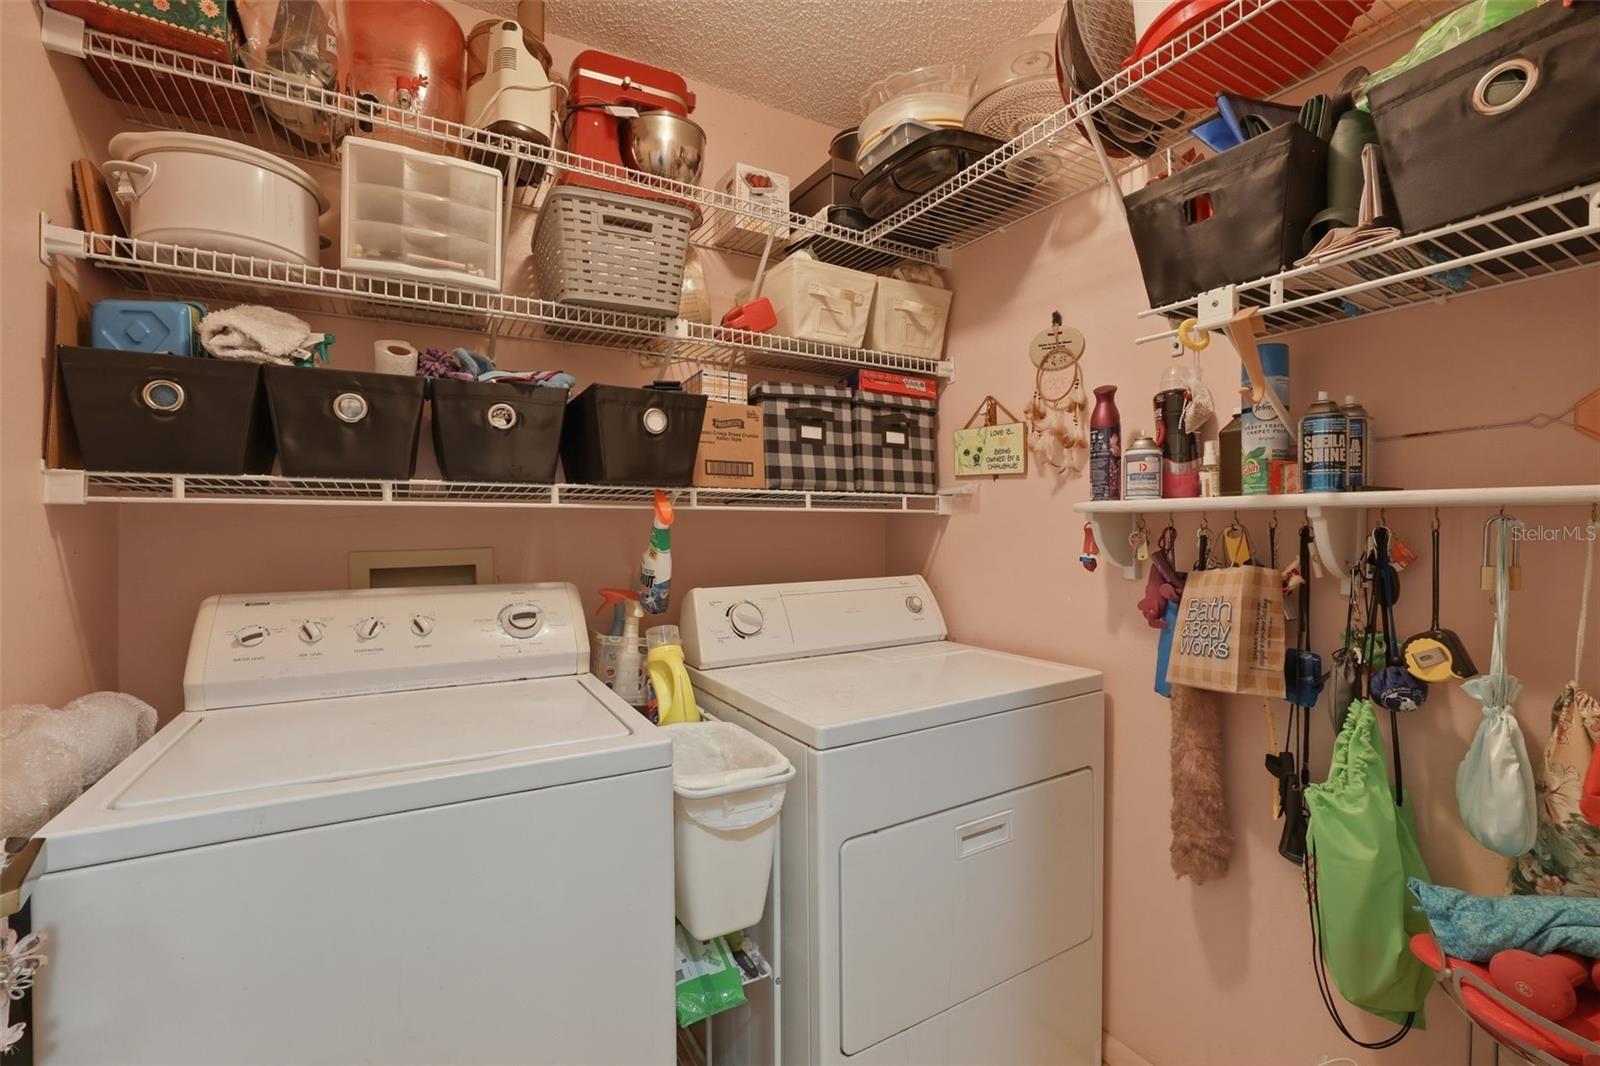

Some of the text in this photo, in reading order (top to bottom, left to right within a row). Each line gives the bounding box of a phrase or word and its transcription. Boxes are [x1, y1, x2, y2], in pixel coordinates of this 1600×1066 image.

[1304, 434, 1346, 449] SHEILA
[985, 455, 1006, 463] OWNED
[1304, 448, 1346, 463] SHINE
[1185, 596, 1233, 623] Bath
[1180, 638, 1229, 659] Works
